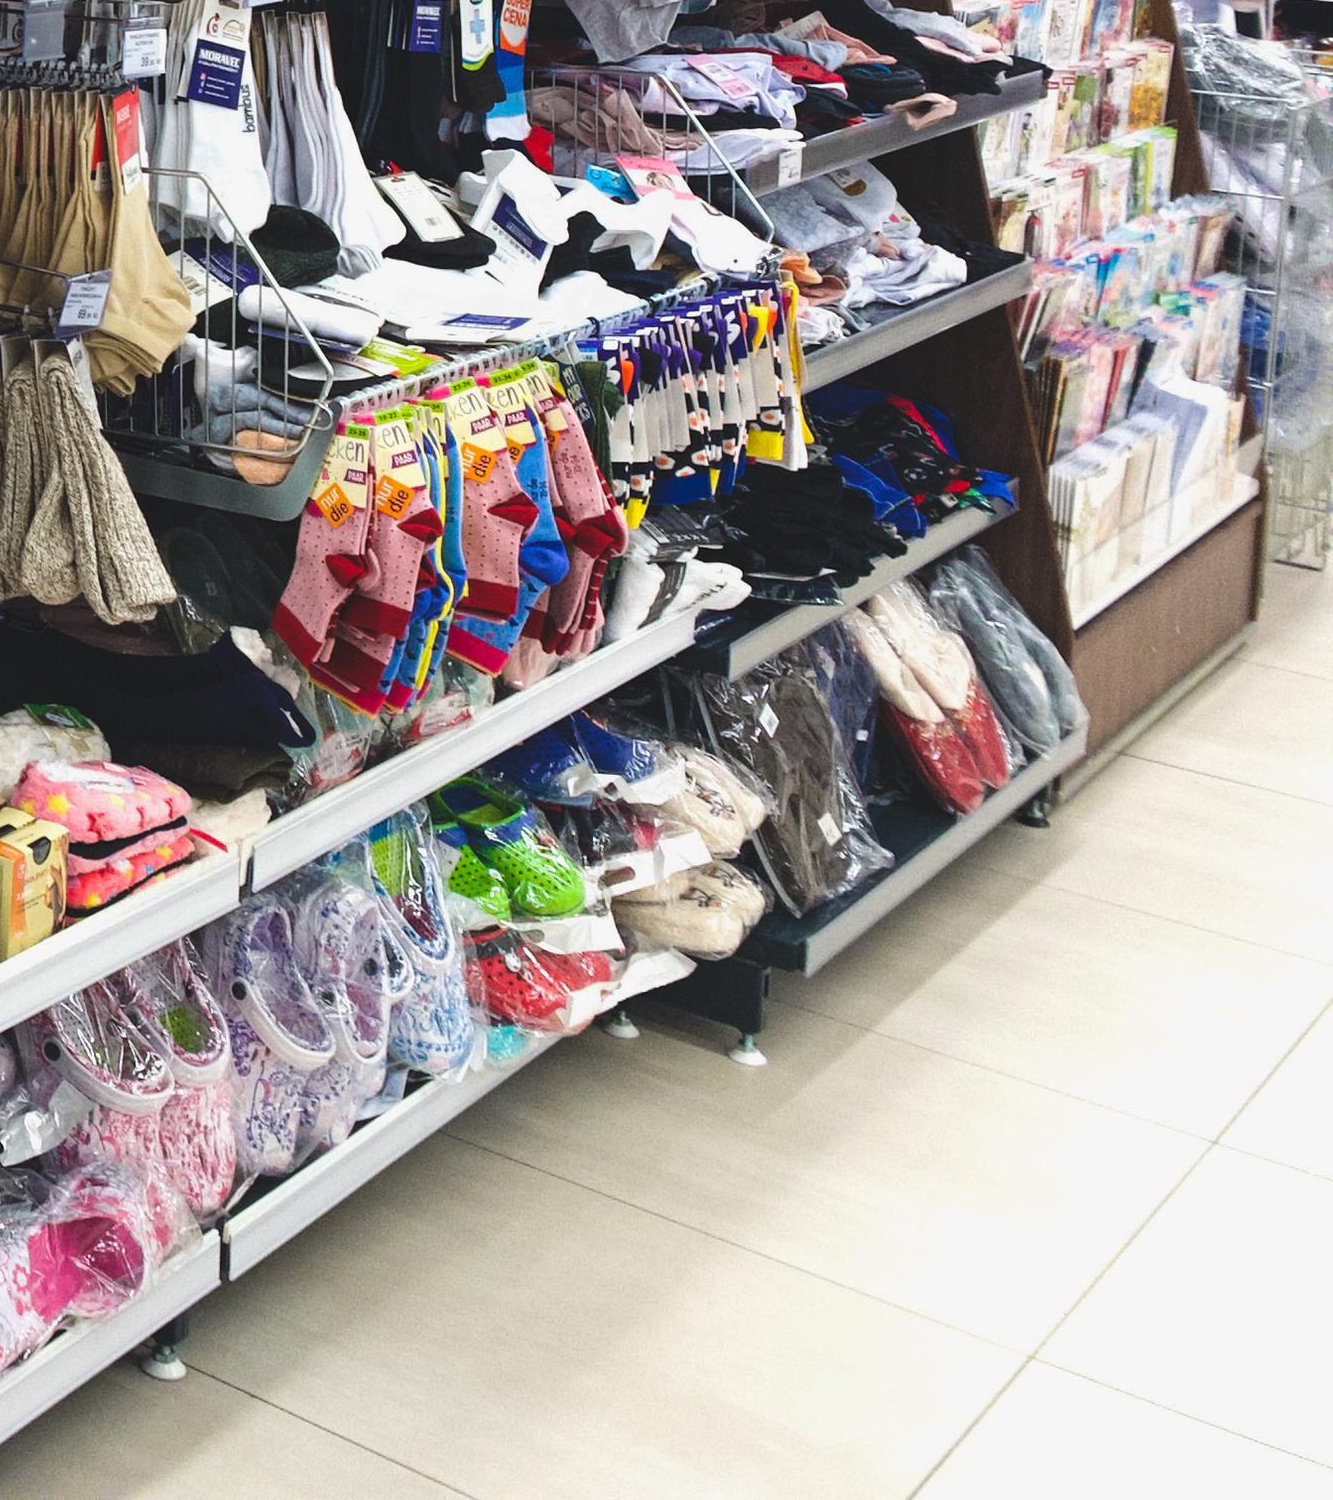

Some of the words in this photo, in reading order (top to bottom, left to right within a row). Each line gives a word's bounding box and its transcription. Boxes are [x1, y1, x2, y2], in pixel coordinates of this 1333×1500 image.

[503, 7, 527, 28] CENA
[199, 47, 242, 68] MORAVEC
[242, 84, 255, 133] bambus
[394, 452, 417, 468] PAAR
[474, 455, 492, 478] die
[346, 469, 366, 482] PAAR
[390, 488, 410, 513] die
[329, 501, 350, 523] die
